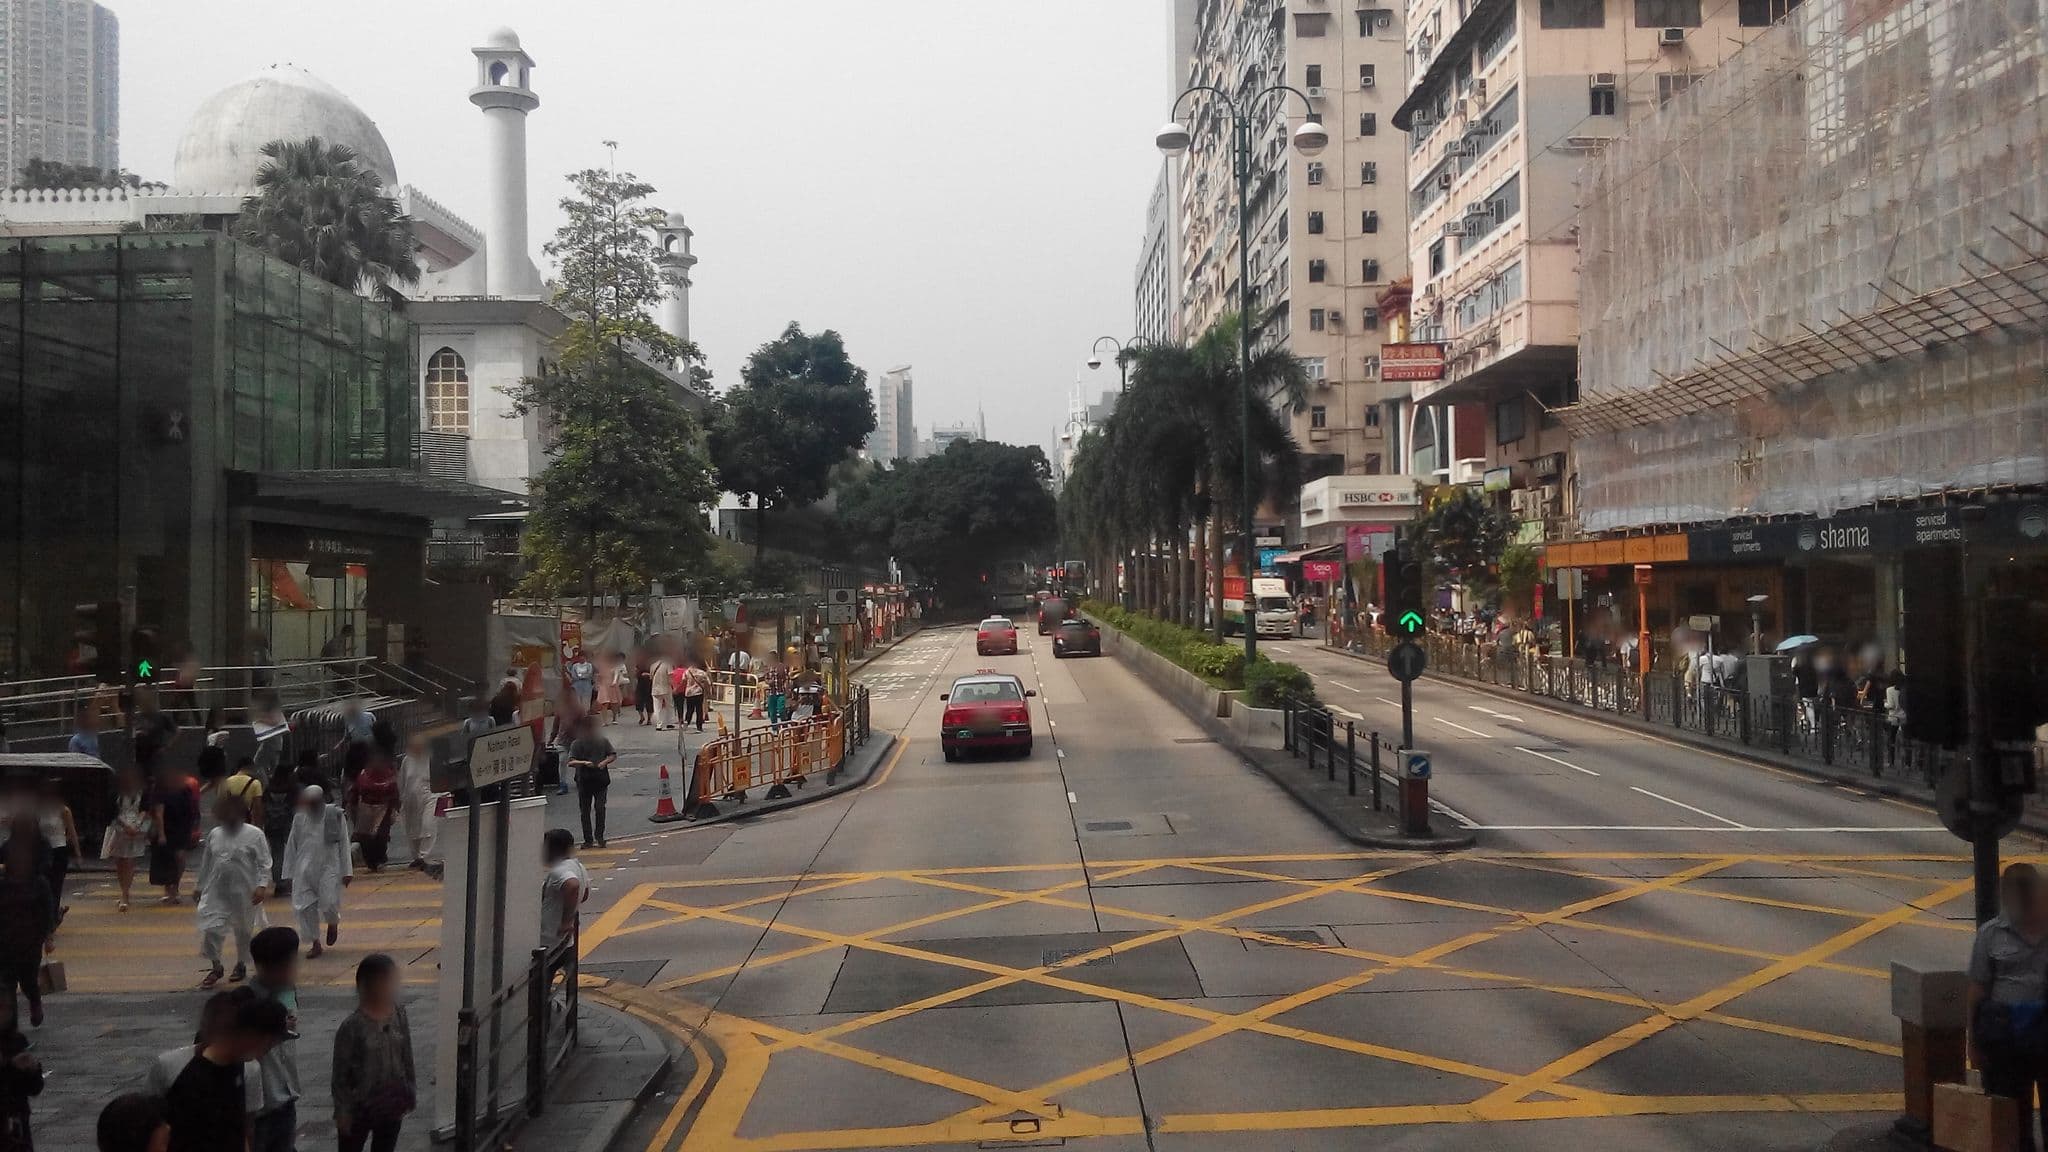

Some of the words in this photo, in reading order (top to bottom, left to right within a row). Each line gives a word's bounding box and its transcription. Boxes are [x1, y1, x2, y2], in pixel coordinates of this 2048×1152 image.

[1344, 492, 1376, 503] HSBC
[1916, 512, 1947, 527] serviced
[1820, 523, 1870, 549] shama
[1916, 527, 1961, 544] apartments
